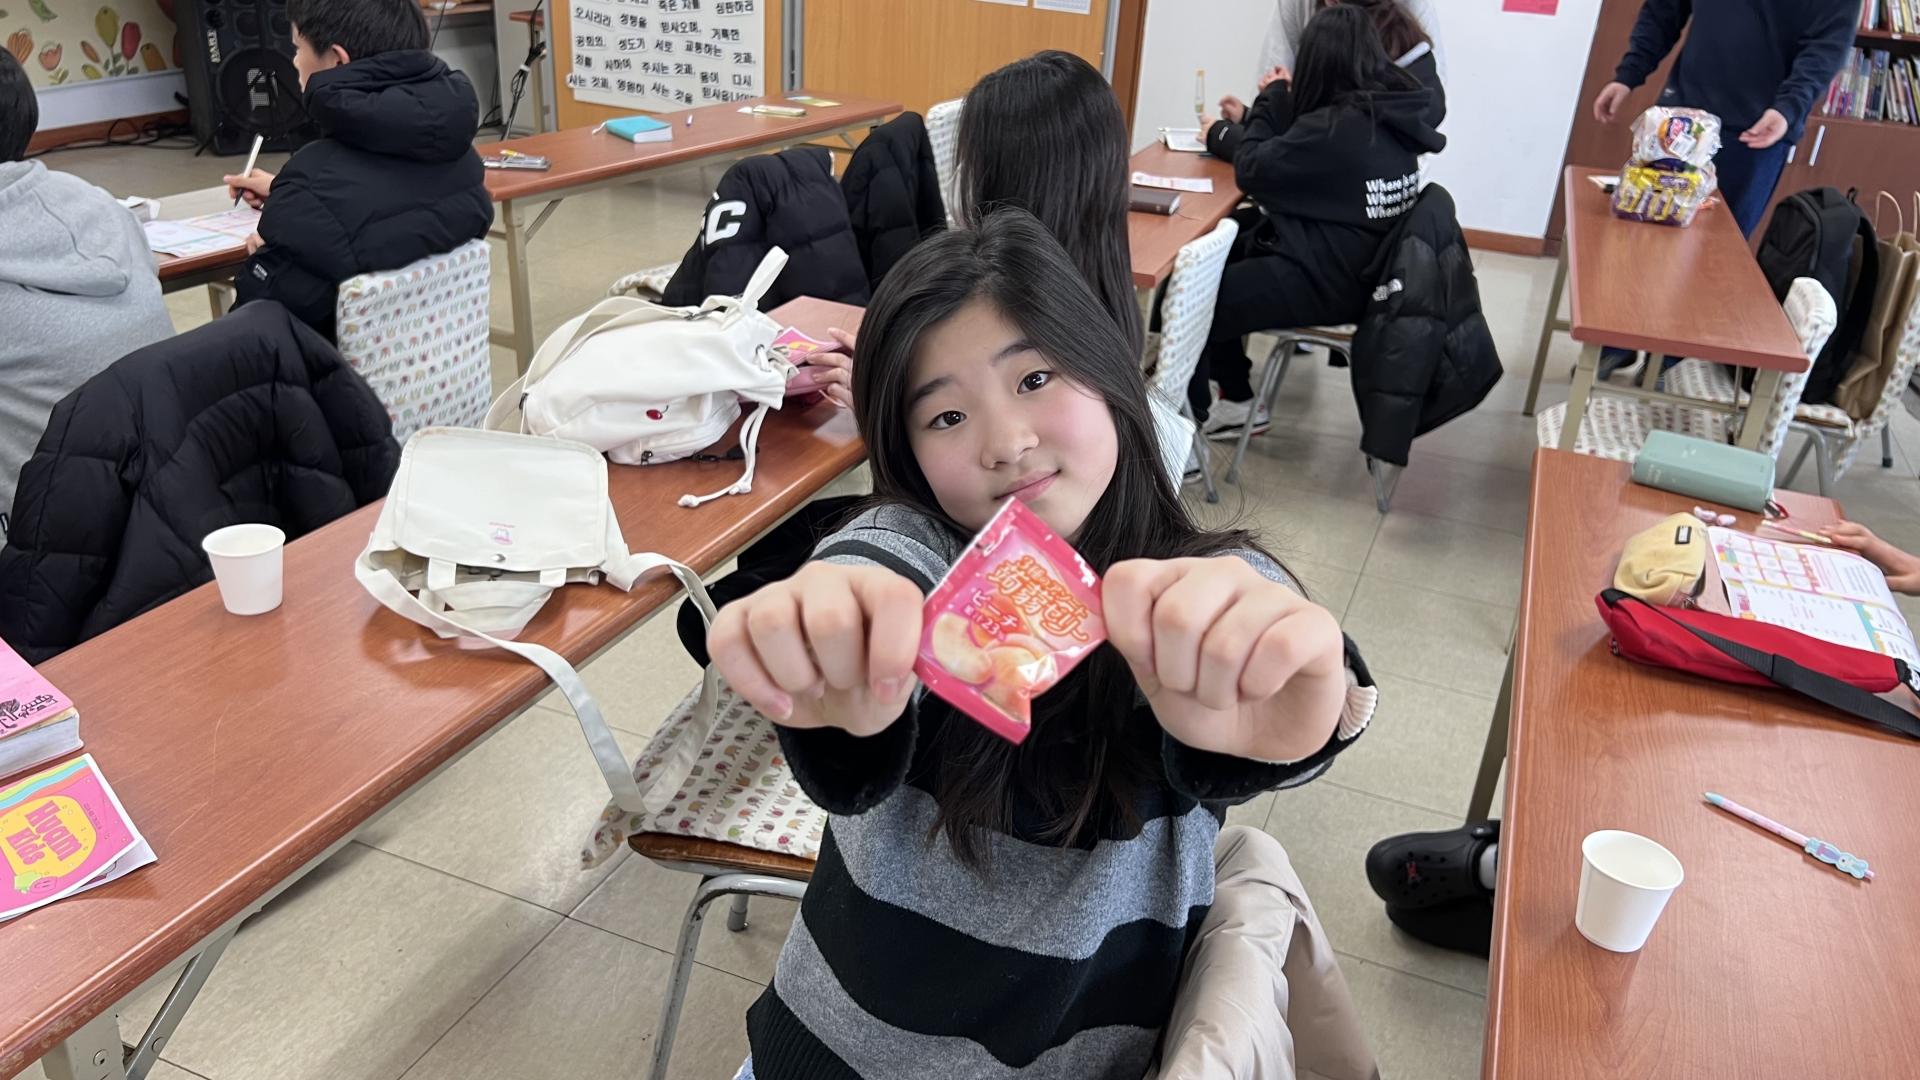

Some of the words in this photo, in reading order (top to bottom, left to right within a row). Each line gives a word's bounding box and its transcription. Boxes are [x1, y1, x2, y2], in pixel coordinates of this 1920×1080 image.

[654, 39, 673, 53] 서로
[732, 74, 752, 86] 다시
[651, 82, 670, 97] 사는
[1366, 178, 1402, 193] Where
[1366, 192, 1402, 206] Where
[1366, 205, 1401, 219] Where
[5, 826, 46, 866] Kids
